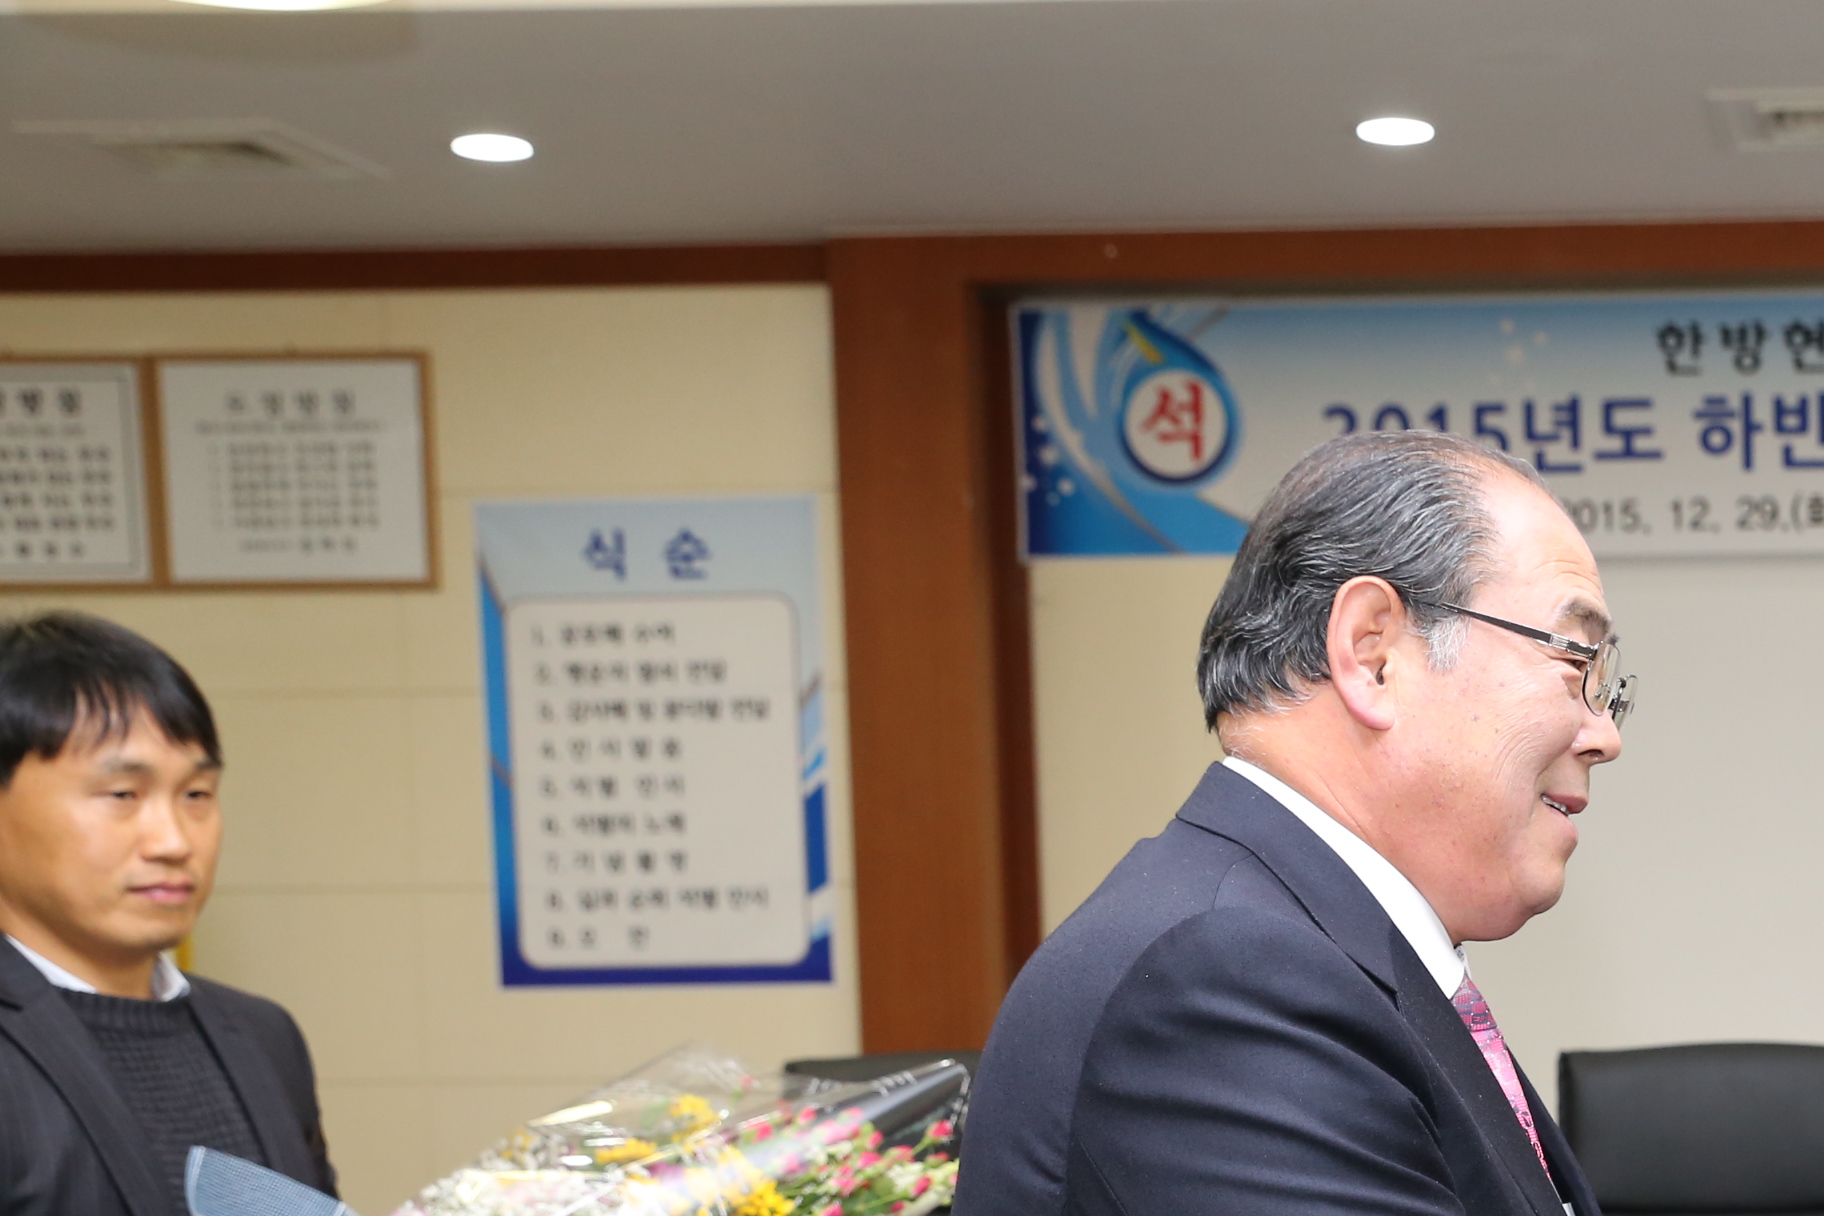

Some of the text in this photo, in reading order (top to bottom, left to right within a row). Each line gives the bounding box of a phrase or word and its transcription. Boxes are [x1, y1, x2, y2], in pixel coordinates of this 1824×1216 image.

[1140, 380, 1205, 463] 석
[1562, 498, 1653, 534] 015.
[1670, 495, 1721, 534] 12.
